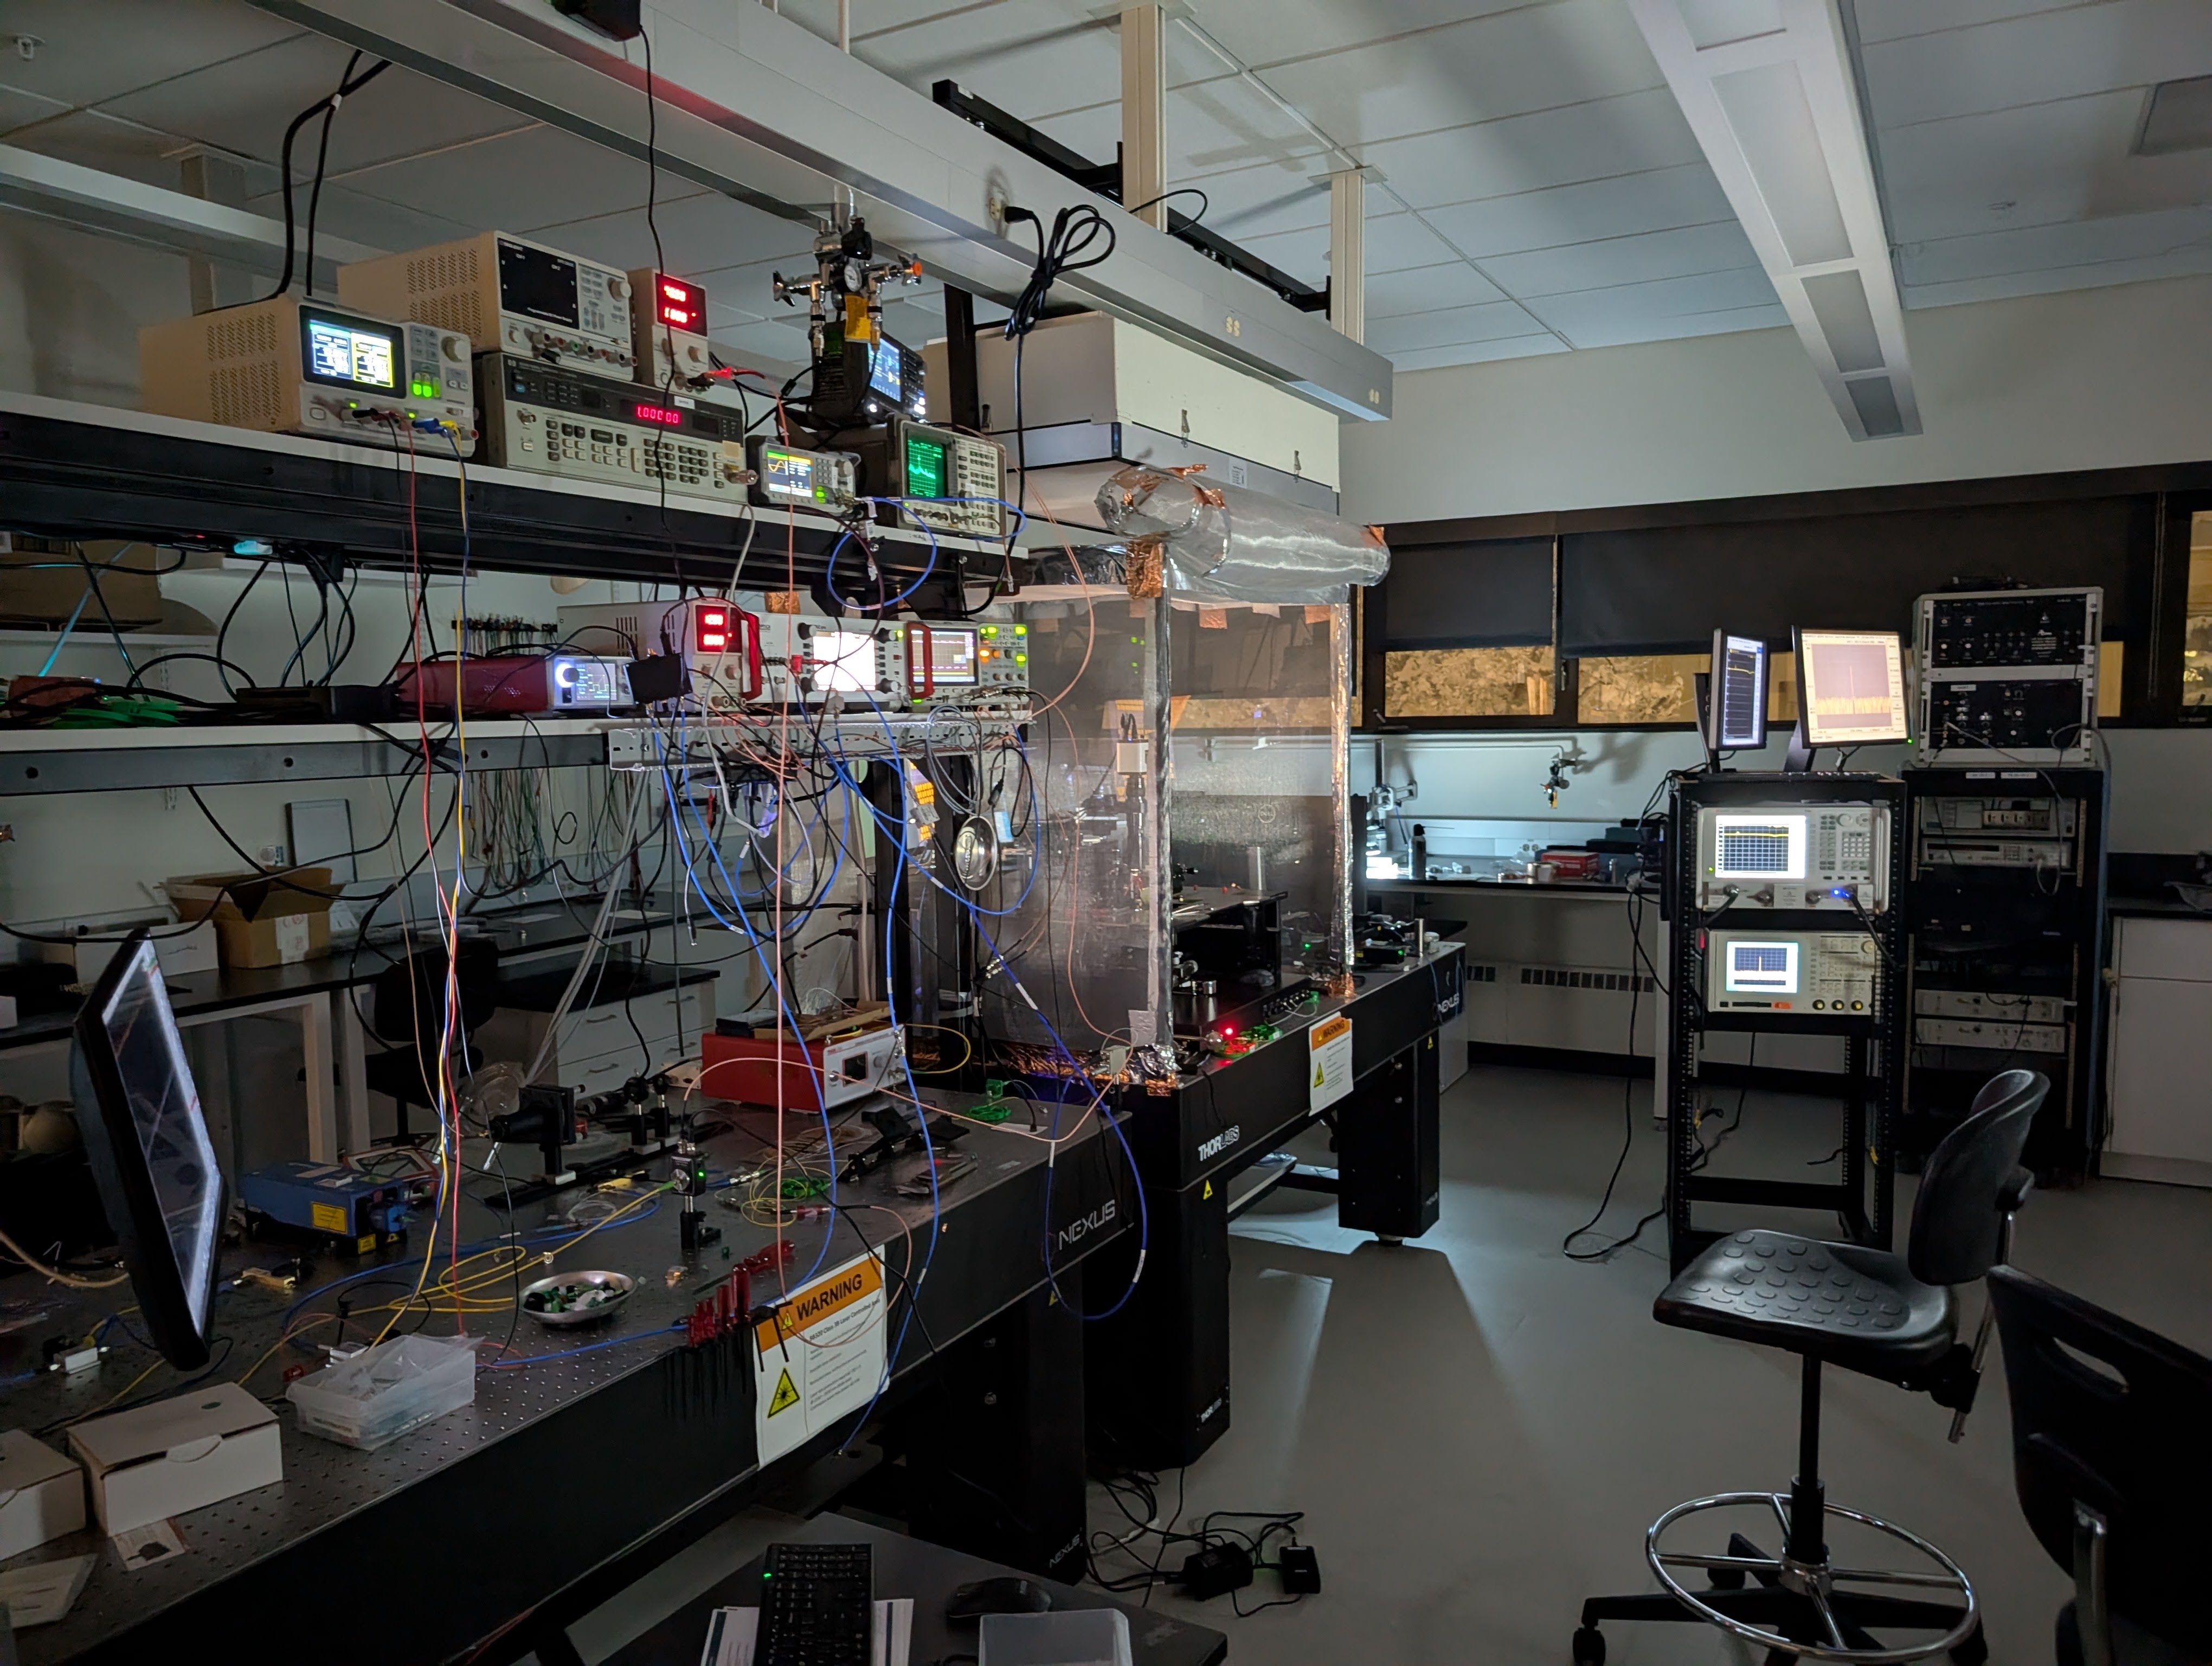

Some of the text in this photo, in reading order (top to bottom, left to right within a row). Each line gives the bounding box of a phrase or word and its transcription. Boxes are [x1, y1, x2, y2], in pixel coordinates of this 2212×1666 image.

[1198, 1125, 1240, 1162] THORLABS
[1058, 1199, 1116, 1251] NEXUS
[796, 1273, 863, 1321] WARNING
[1049, 1533, 1081, 1569] NEXUS
